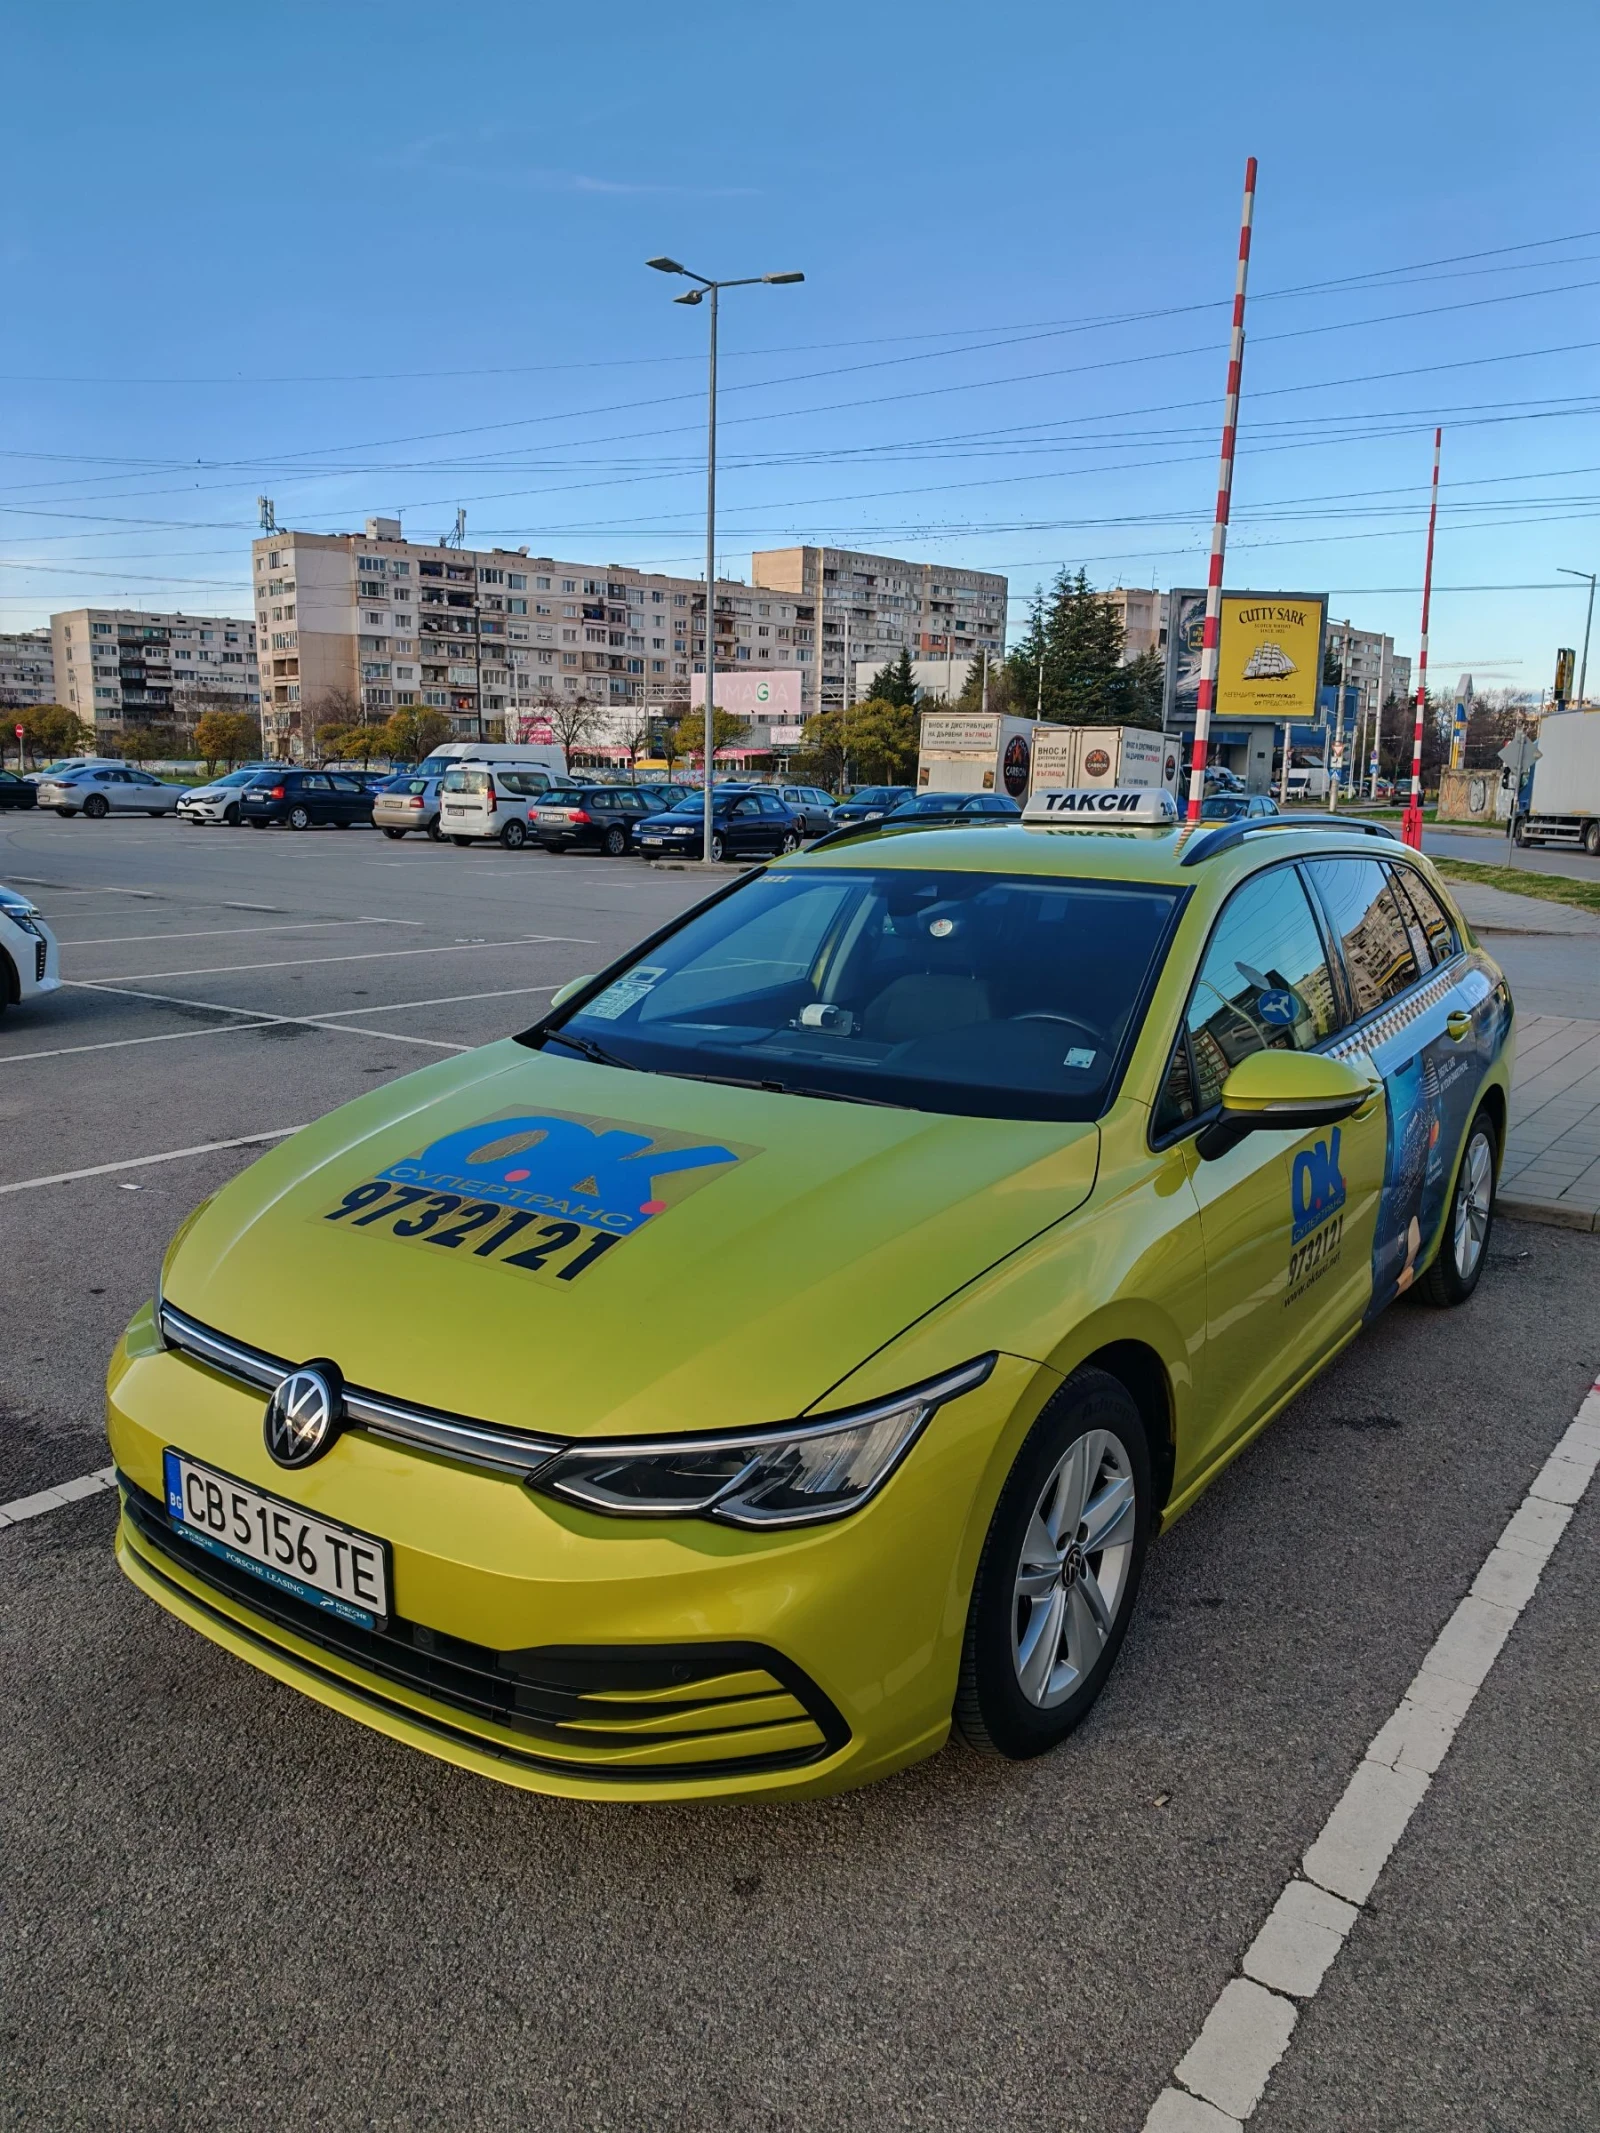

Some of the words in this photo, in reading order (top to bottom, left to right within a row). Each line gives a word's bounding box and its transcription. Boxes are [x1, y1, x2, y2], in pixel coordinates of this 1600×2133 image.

[1238, 607, 1276, 624] CUTTY
[1276, 607, 1308, 626] SARK
[950, 722, 993, 730] ДИСТРИБУЦИЯ
[1037, 747, 1060, 755] ВНОС
[1061, 747, 1067, 755] И
[1005, 766, 1027, 777] CARBON
[1045, 794, 1142, 811] ТАКСИ
[388, 1166, 634, 1228] СУПЕРТРАНС
[1292, 1193, 1346, 1242] СУПЕРТРАНС
[323, 1181, 624, 1283] 9732121
[1289, 1213, 1344, 1288] 9732121
[1284, 1251, 1342, 1308] www.oktaxi.net
[169, 1491, 182, 1510] BG
[225, 1551, 264, 1577] PORSCHE
[266, 1571, 304, 1596] LEASING
[335, 1602, 367, 1621] PORSCHE
